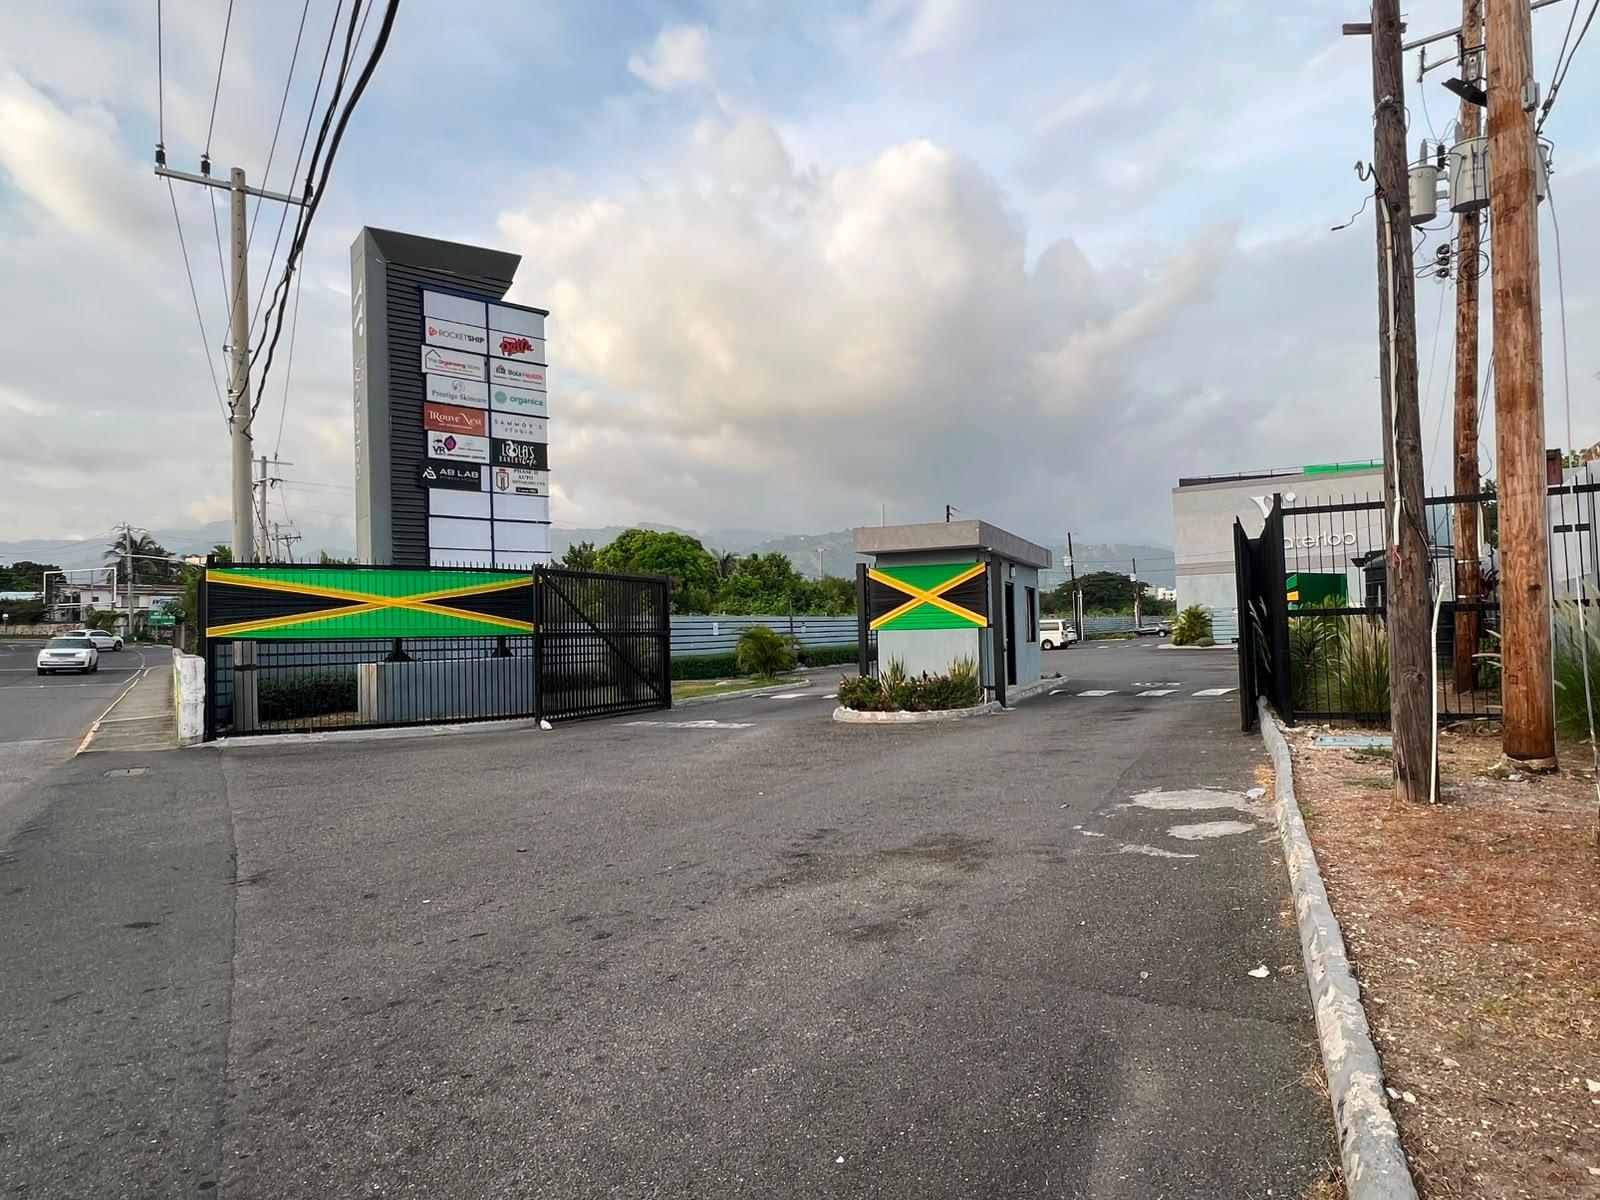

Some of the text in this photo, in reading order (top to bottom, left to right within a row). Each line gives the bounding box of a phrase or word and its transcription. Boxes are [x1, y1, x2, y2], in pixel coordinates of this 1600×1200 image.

[439, 330, 485, 343] ROCKETSHIP
[431, 390, 487, 403] Prestige Skincare
[510, 396, 544, 406] organica
[432, 446, 446, 455] VR
[439, 468, 479, 478] AB LAB
[1283, 531, 1357, 550] aterloo
